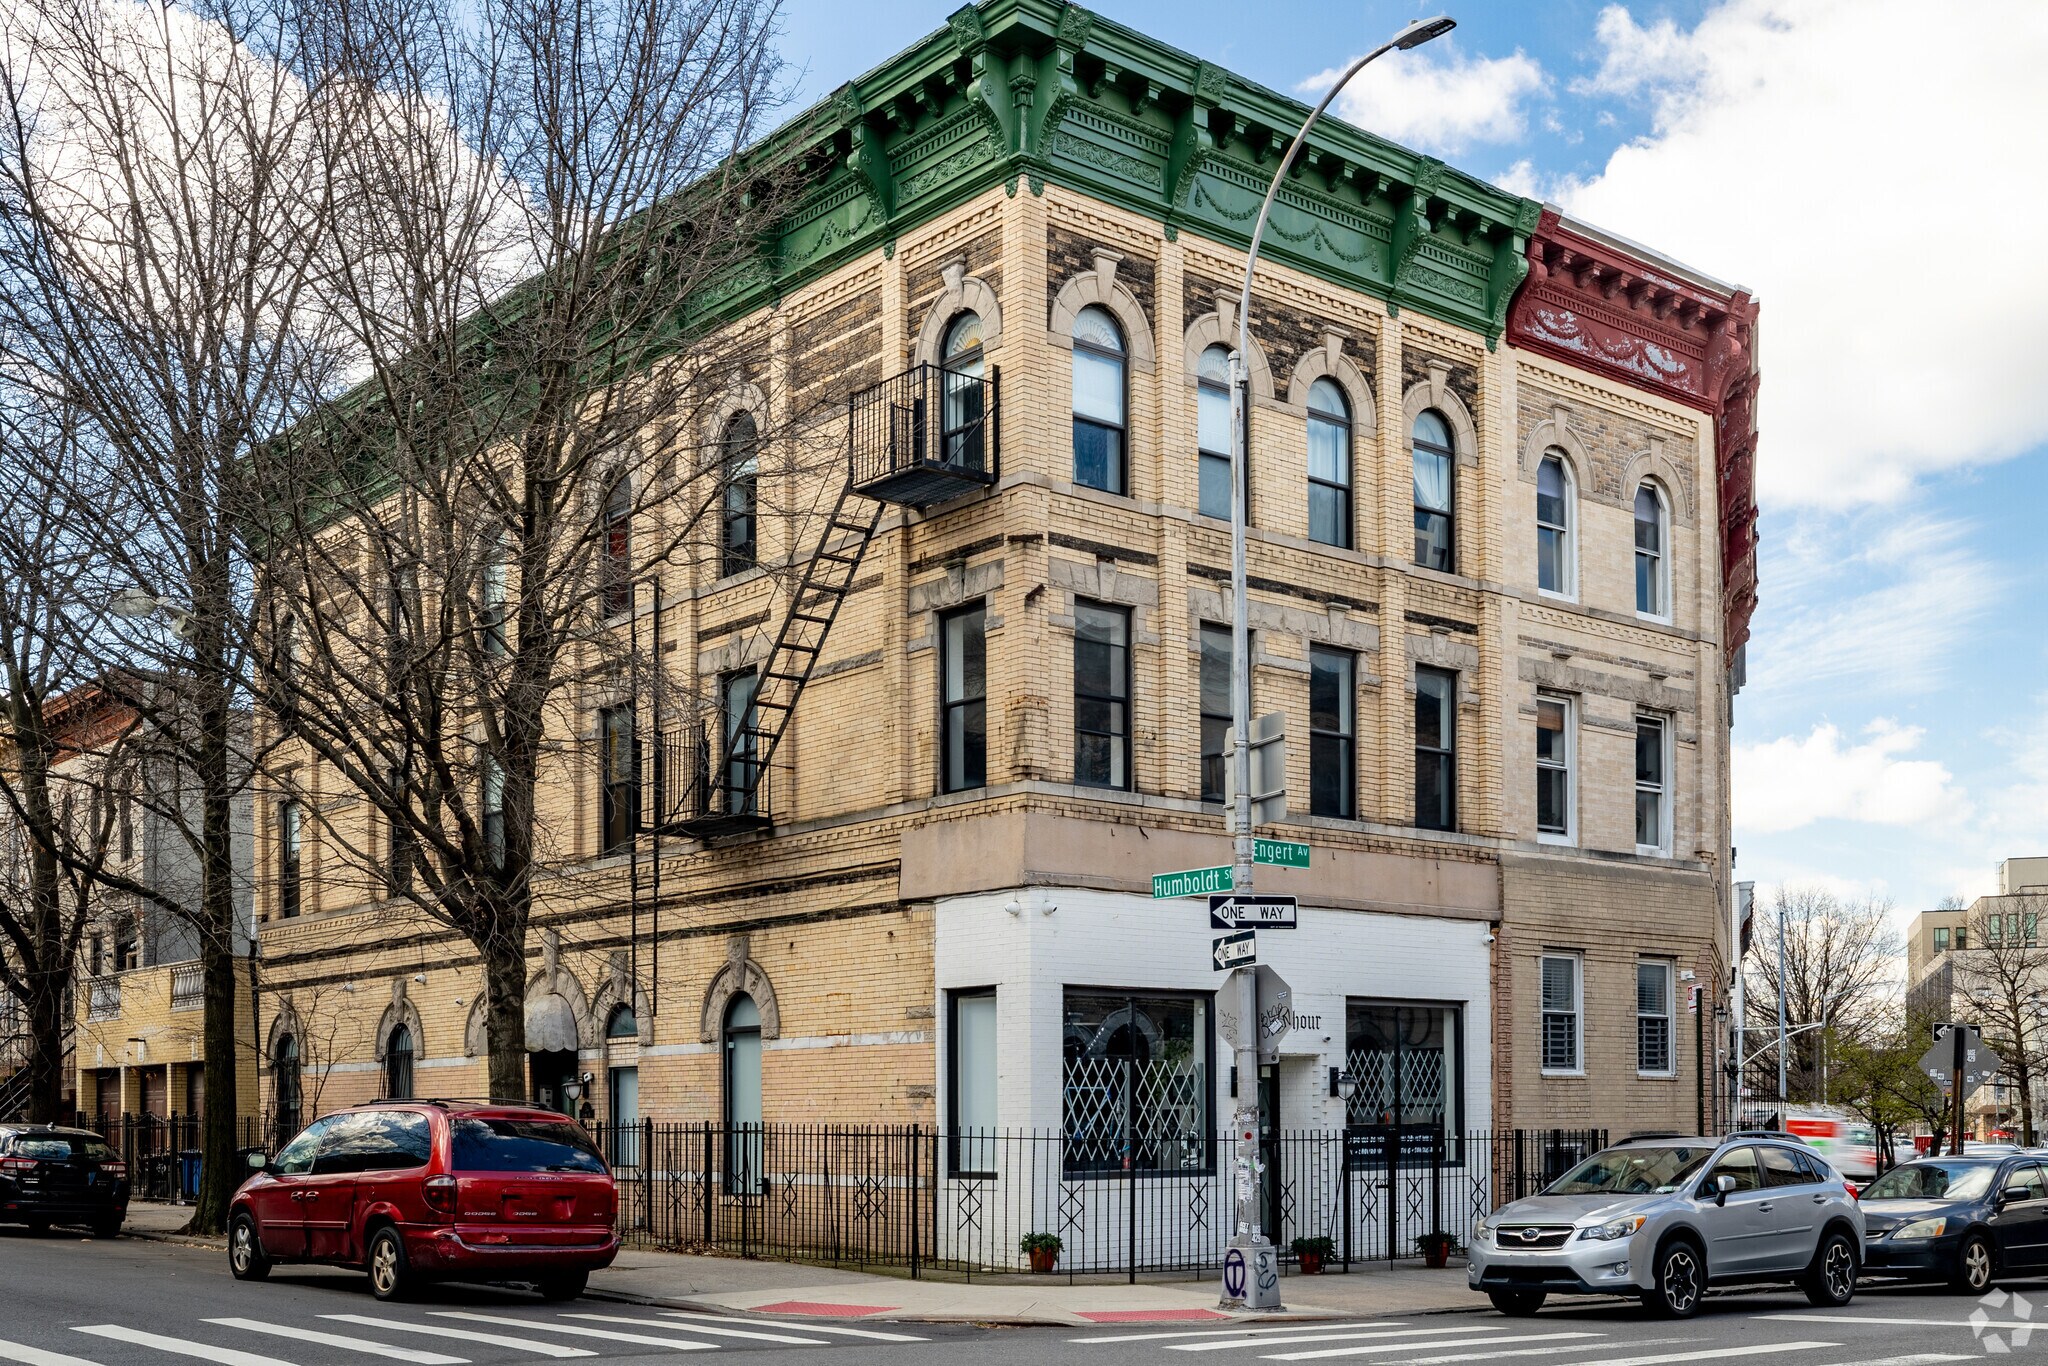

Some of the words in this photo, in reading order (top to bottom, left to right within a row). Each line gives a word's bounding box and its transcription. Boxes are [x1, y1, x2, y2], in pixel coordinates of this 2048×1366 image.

[1253, 840, 1293, 863] Engert
[1297, 846, 1308, 856] Av
[1154, 870, 1220, 897] Humboldt
[1224, 869, 1233, 880] St
[1221, 906, 1245, 919] ONE
[1260, 906, 1285, 920] WAY
[1217, 946, 1230, 960] ONE
[1236, 941, 1250, 956] WAY
[1292, 1009, 1322, 1033] hour
